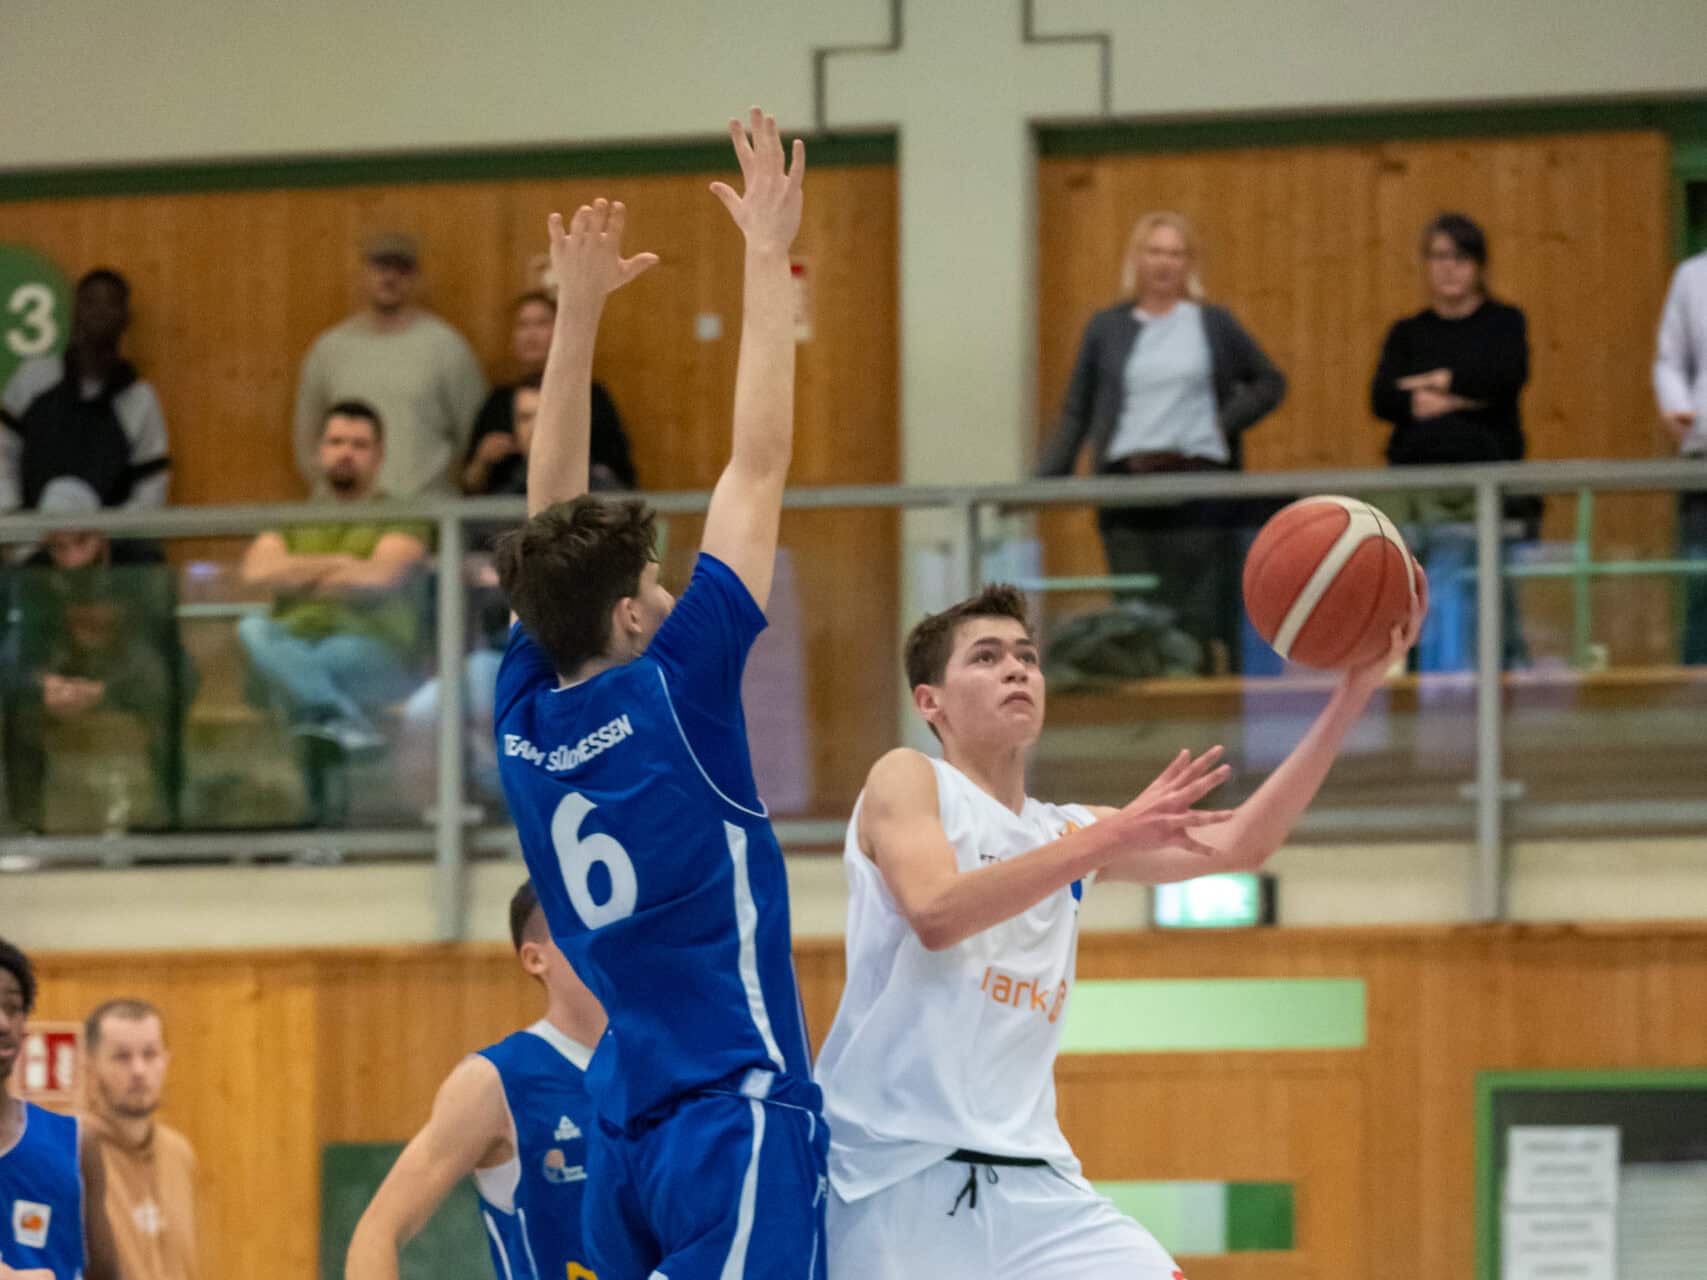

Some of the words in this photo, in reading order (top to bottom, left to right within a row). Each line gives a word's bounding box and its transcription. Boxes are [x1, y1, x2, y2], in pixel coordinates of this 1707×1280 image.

[7, 283, 56, 353] 3
[545, 714, 634, 771] SÜDESSEN
[551, 792, 639, 930] 6
